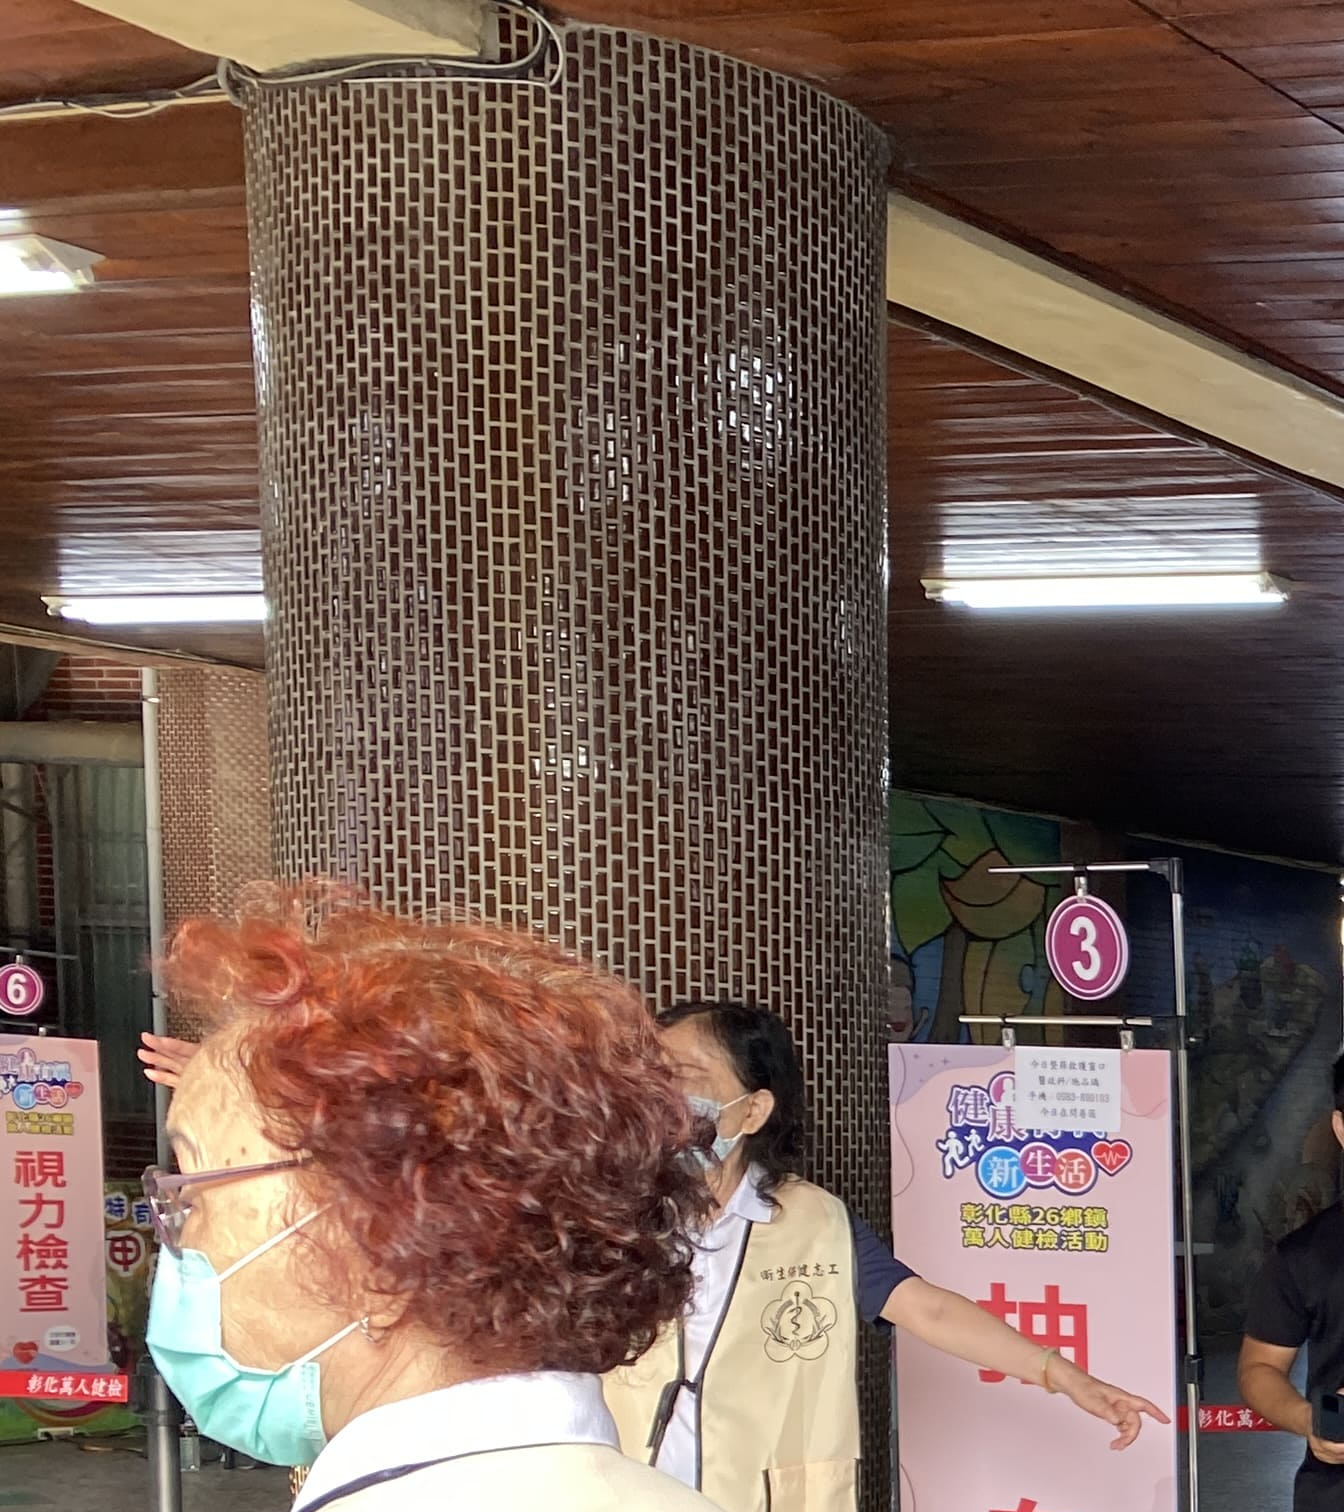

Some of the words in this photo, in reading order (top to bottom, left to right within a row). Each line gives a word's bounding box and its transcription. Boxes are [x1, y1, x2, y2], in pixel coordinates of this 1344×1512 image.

[1069, 916, 1101, 981] 3
[6, 972, 27, 1005] 6
[988, 1149, 1087, 1188] 新生活
[960, 1202, 1108, 1228] 彰化縣26鄉鎮
[14, 1150, 69, 1313] 視力檢查
[962, 1226, 1109, 1252] 萬人健檢活動
[760, 1262, 839, 1281] 衛生保健志工
[27, 1374, 123, 1397] 彰化萬人健檢
